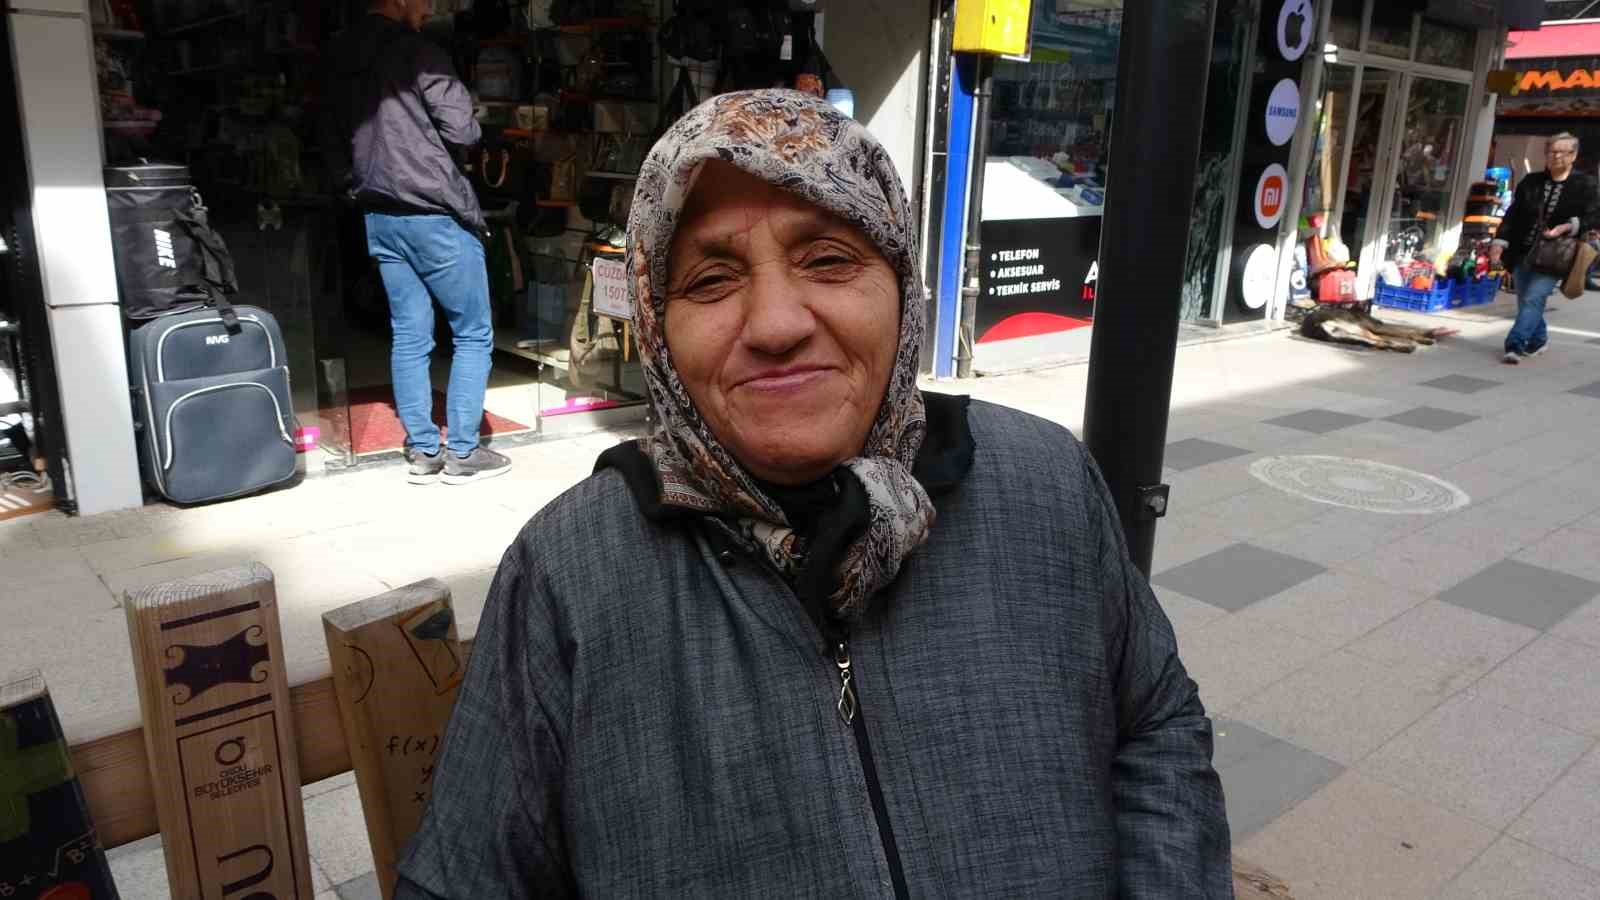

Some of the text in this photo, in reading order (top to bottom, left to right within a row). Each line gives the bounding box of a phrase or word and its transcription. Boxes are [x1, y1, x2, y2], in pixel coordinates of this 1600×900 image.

[1268, 105, 1298, 118] SAMSUNG
[153, 228, 177, 269] NIKE
[998, 248, 1040, 262] TELEFON
[997, 264, 1044, 279] AKSESUAR
[996, 278, 1061, 296] TEKNİK SERVİS
